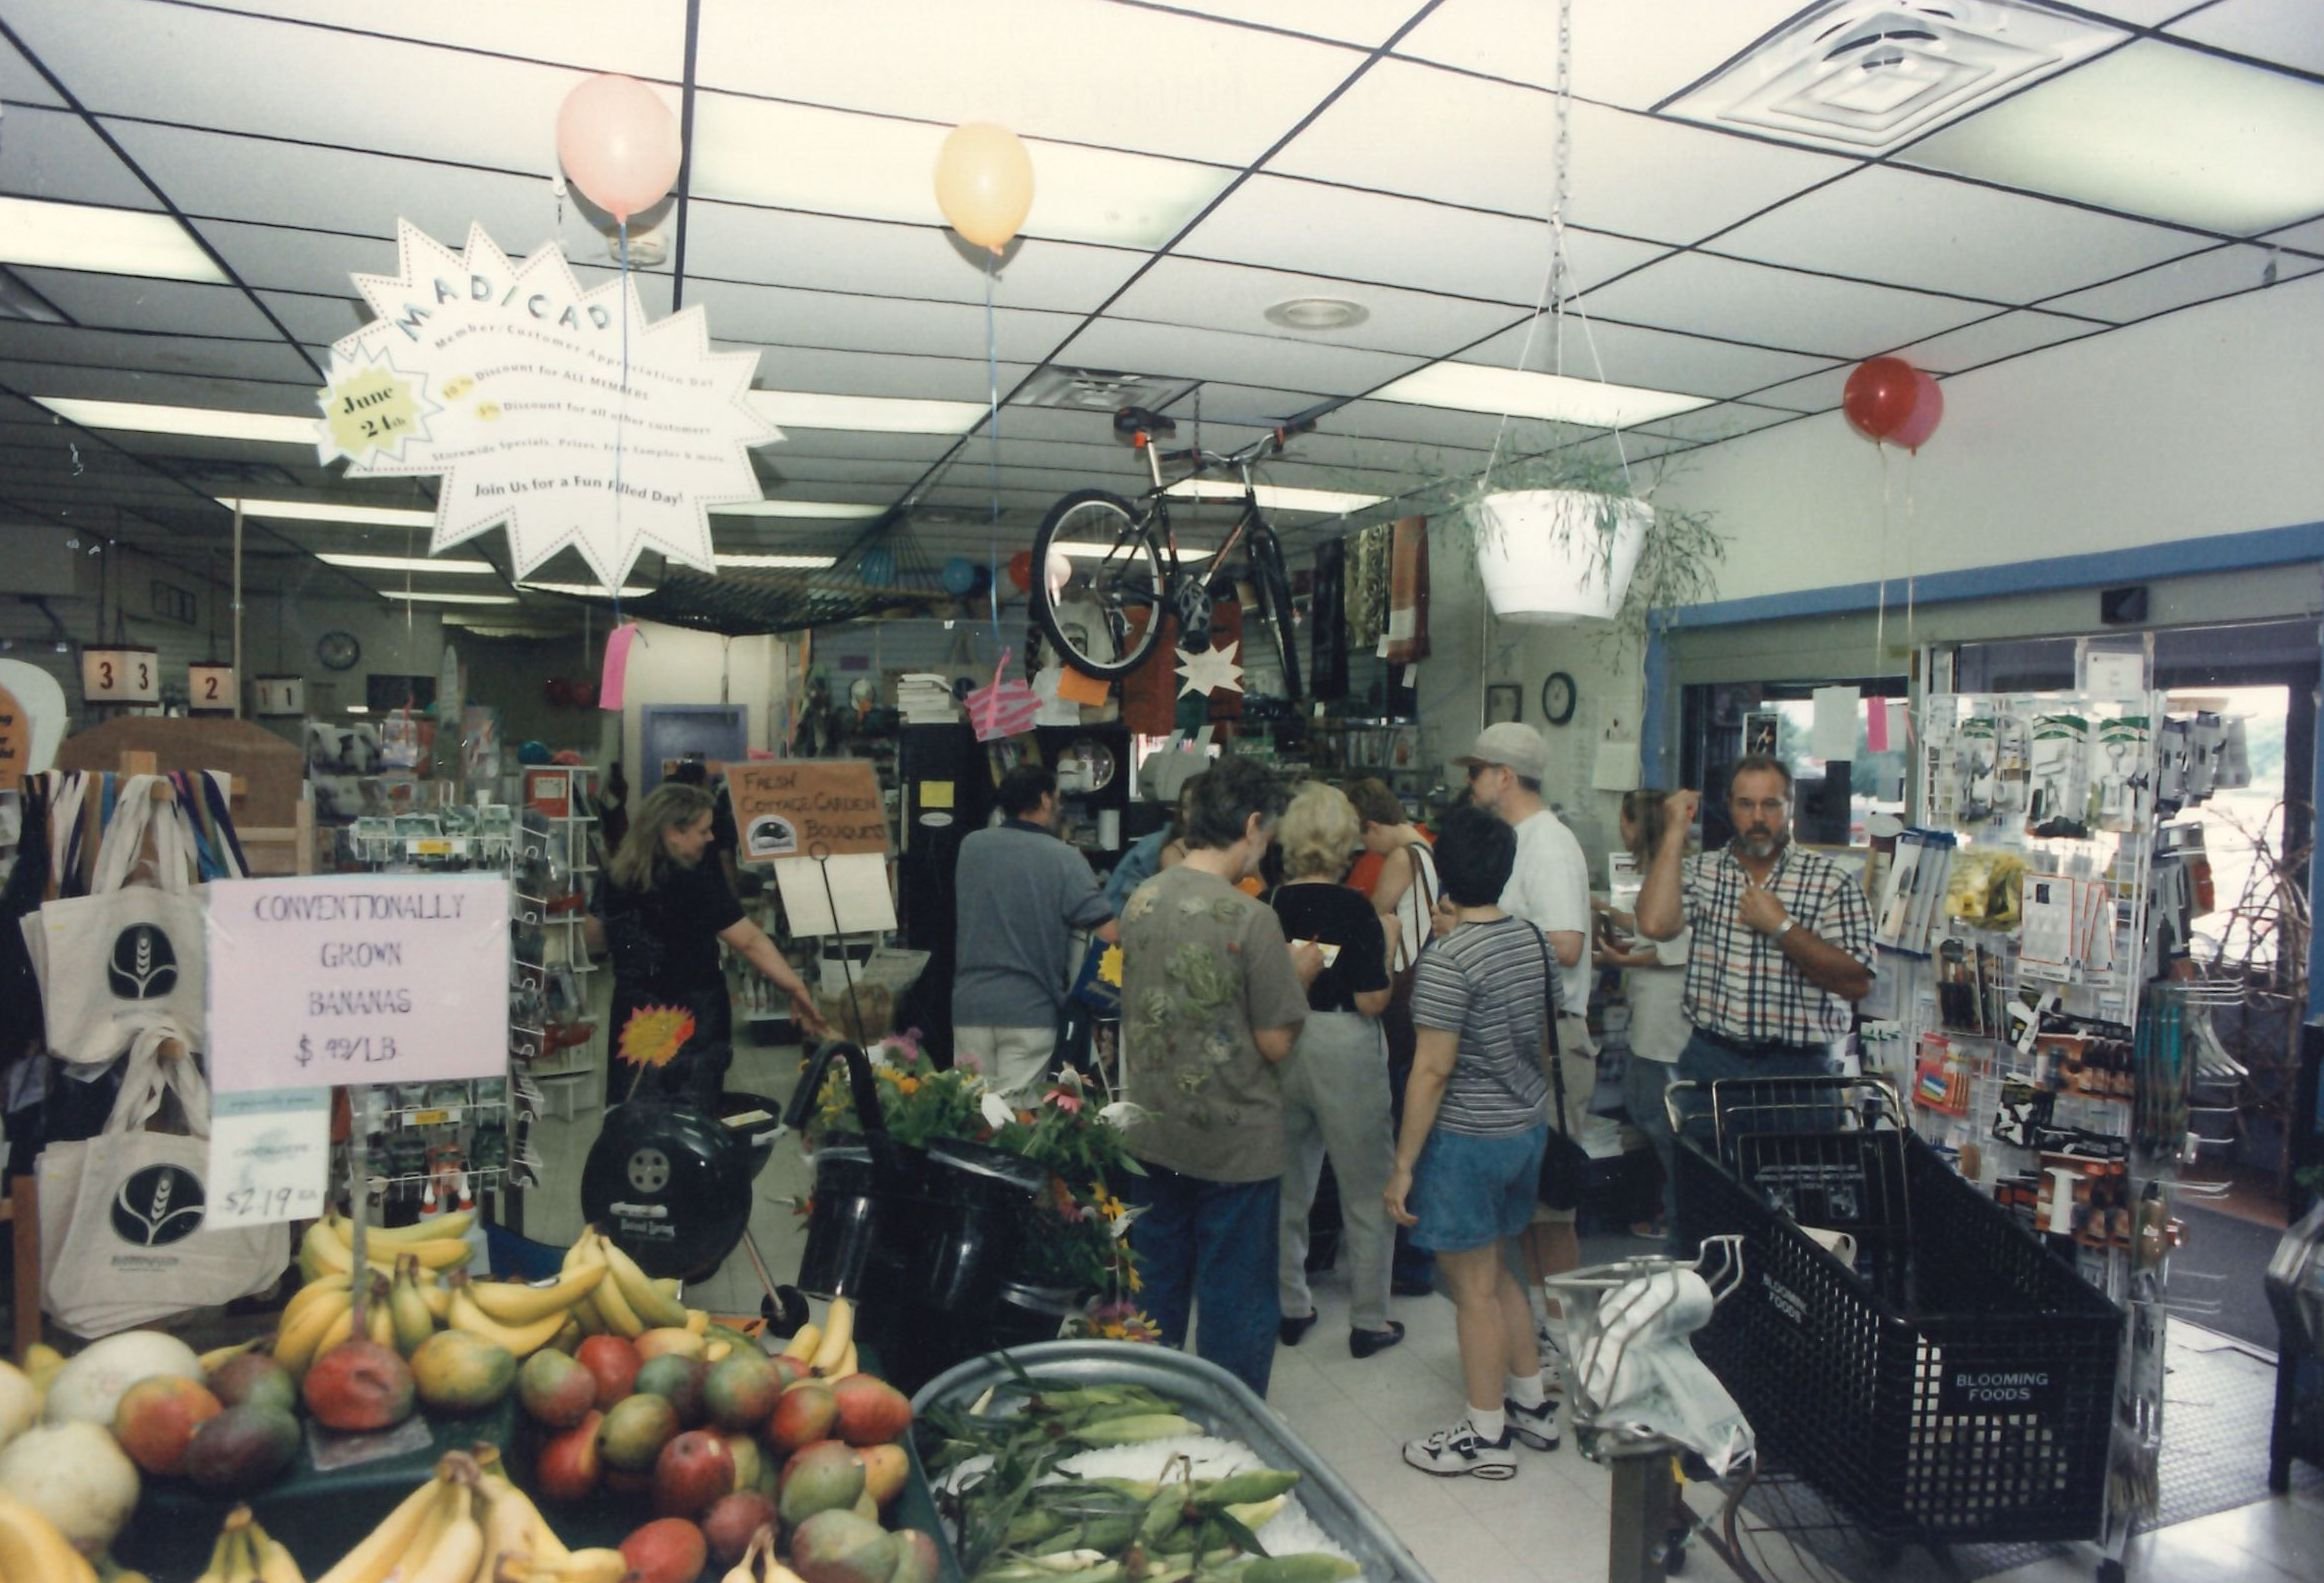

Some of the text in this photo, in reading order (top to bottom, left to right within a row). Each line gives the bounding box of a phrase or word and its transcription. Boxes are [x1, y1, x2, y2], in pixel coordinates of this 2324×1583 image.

[395, 274, 611, 342] MAD/CAD
[475, 364, 533, 381] Discount
[539, 365, 557, 377] for
[563, 369, 584, 383] ALL
[343, 387, 393, 415] June
[503, 401, 561, 412] Discount
[567, 403, 585, 413] for
[591, 408, 606, 418] all
[610, 413, 644, 426] other
[648, 422, 711, 435] customers
[432, 445, 495, 462] Storewide
[475, 483, 505, 497] Join
[510, 481, 528, 493] Us
[532, 478, 555, 489] for
[560, 479, 568, 488] a
[574, 475, 602, 488] Fun
[651, 490, 683, 506] Day!
[100, 661, 114, 690] 3
[138, 663, 149, 690] 3
[205, 676, 218, 700] 2
[286, 687, 292, 706] 1
[814, 791, 877, 812] GARDEN
[254, 894, 465, 921] CONVENTIONALLY
[321, 942, 402, 968] GROWN
[309, 989, 412, 1016] BANANAS
[1956, 1373, 2048, 1387] BLOOMING
[1969, 1387, 2031, 1401] FOODS
